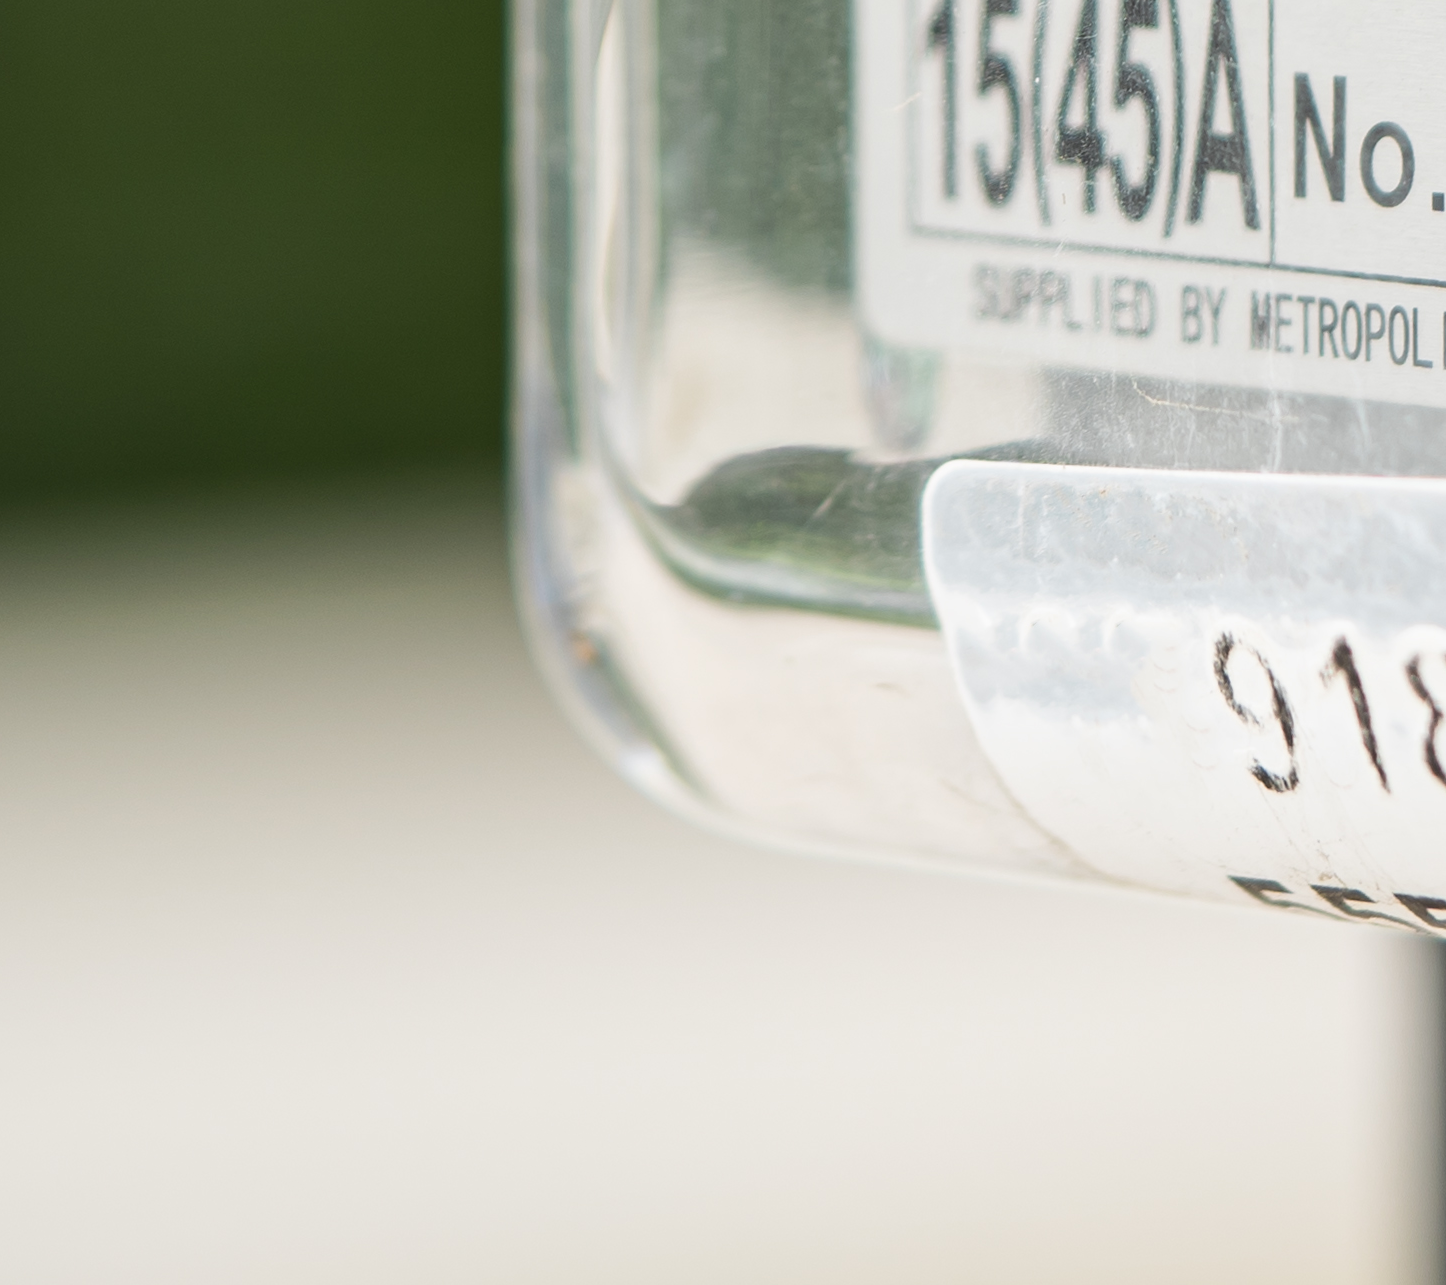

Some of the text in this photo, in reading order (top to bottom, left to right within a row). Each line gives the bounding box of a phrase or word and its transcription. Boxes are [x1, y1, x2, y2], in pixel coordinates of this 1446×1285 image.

[1294, 72, 1445, 212] No.
[973, 262, 1154, 339] SUPPLIED
[1181, 285, 1227, 347] BY
